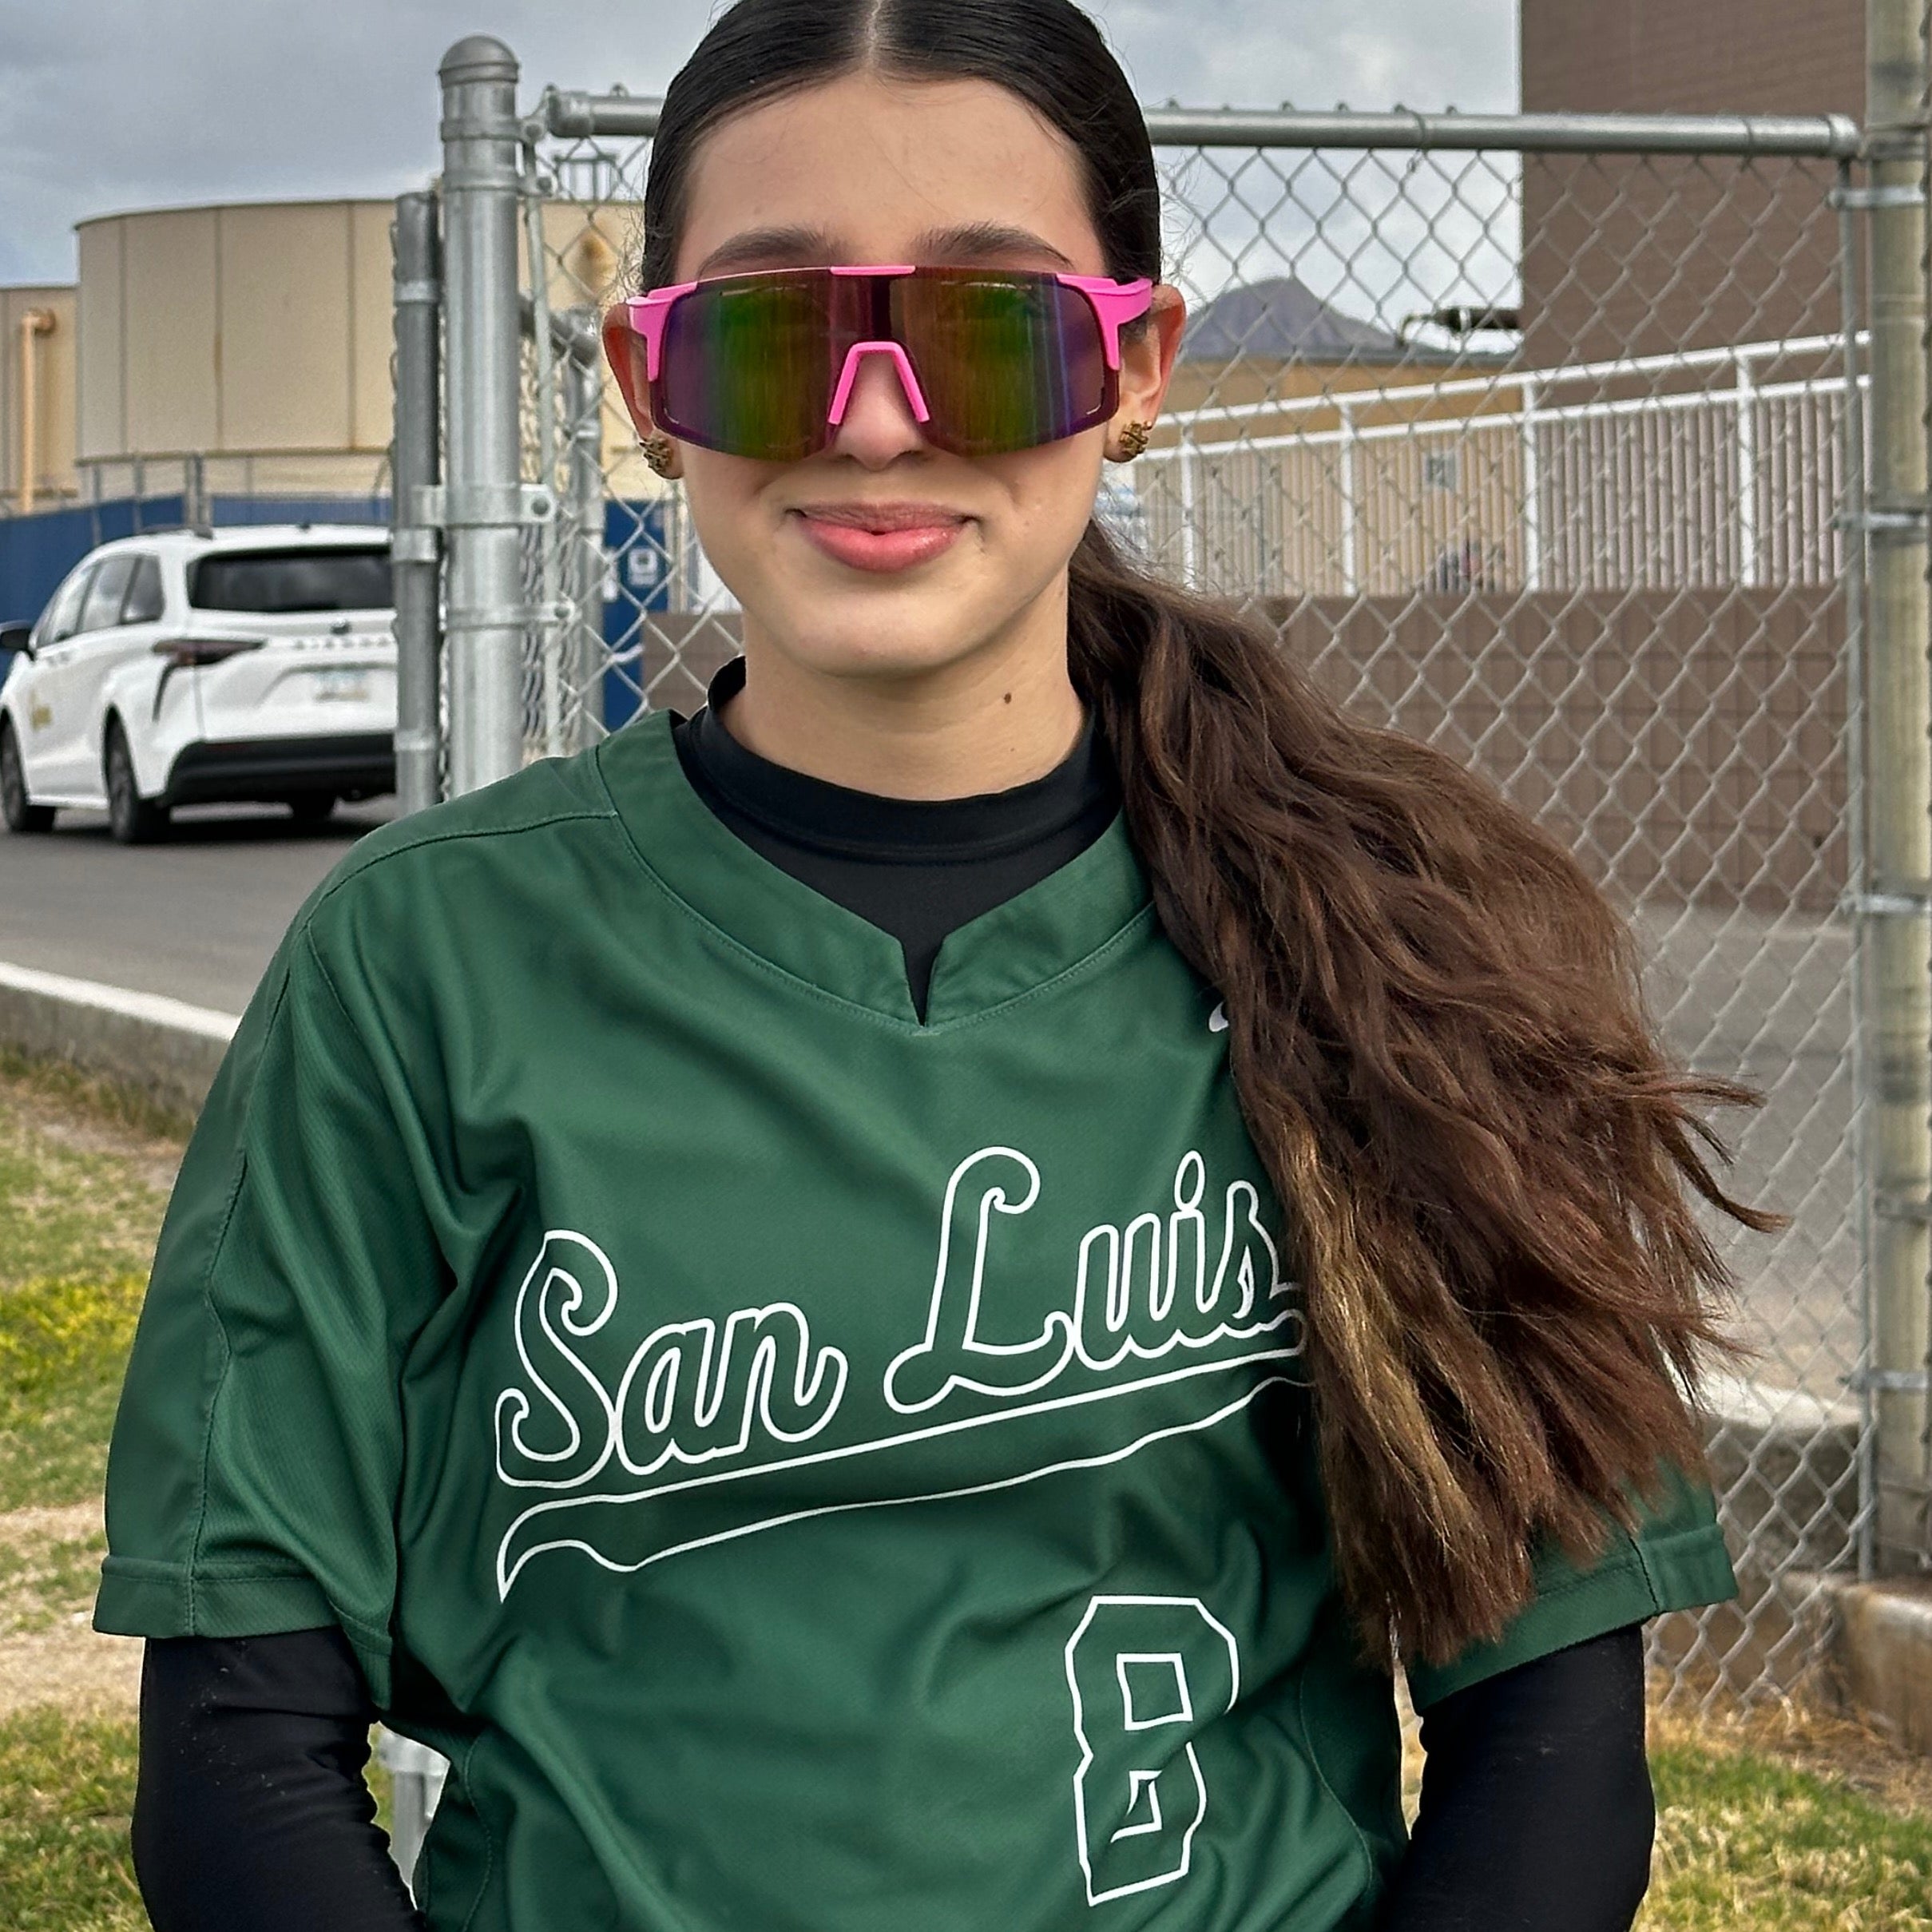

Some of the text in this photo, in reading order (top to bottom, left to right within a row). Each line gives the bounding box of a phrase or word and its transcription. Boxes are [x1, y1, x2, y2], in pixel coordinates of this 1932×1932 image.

[495, 1145, 1307, 1489] San Luis
[1065, 1595, 1240, 1907] 8
